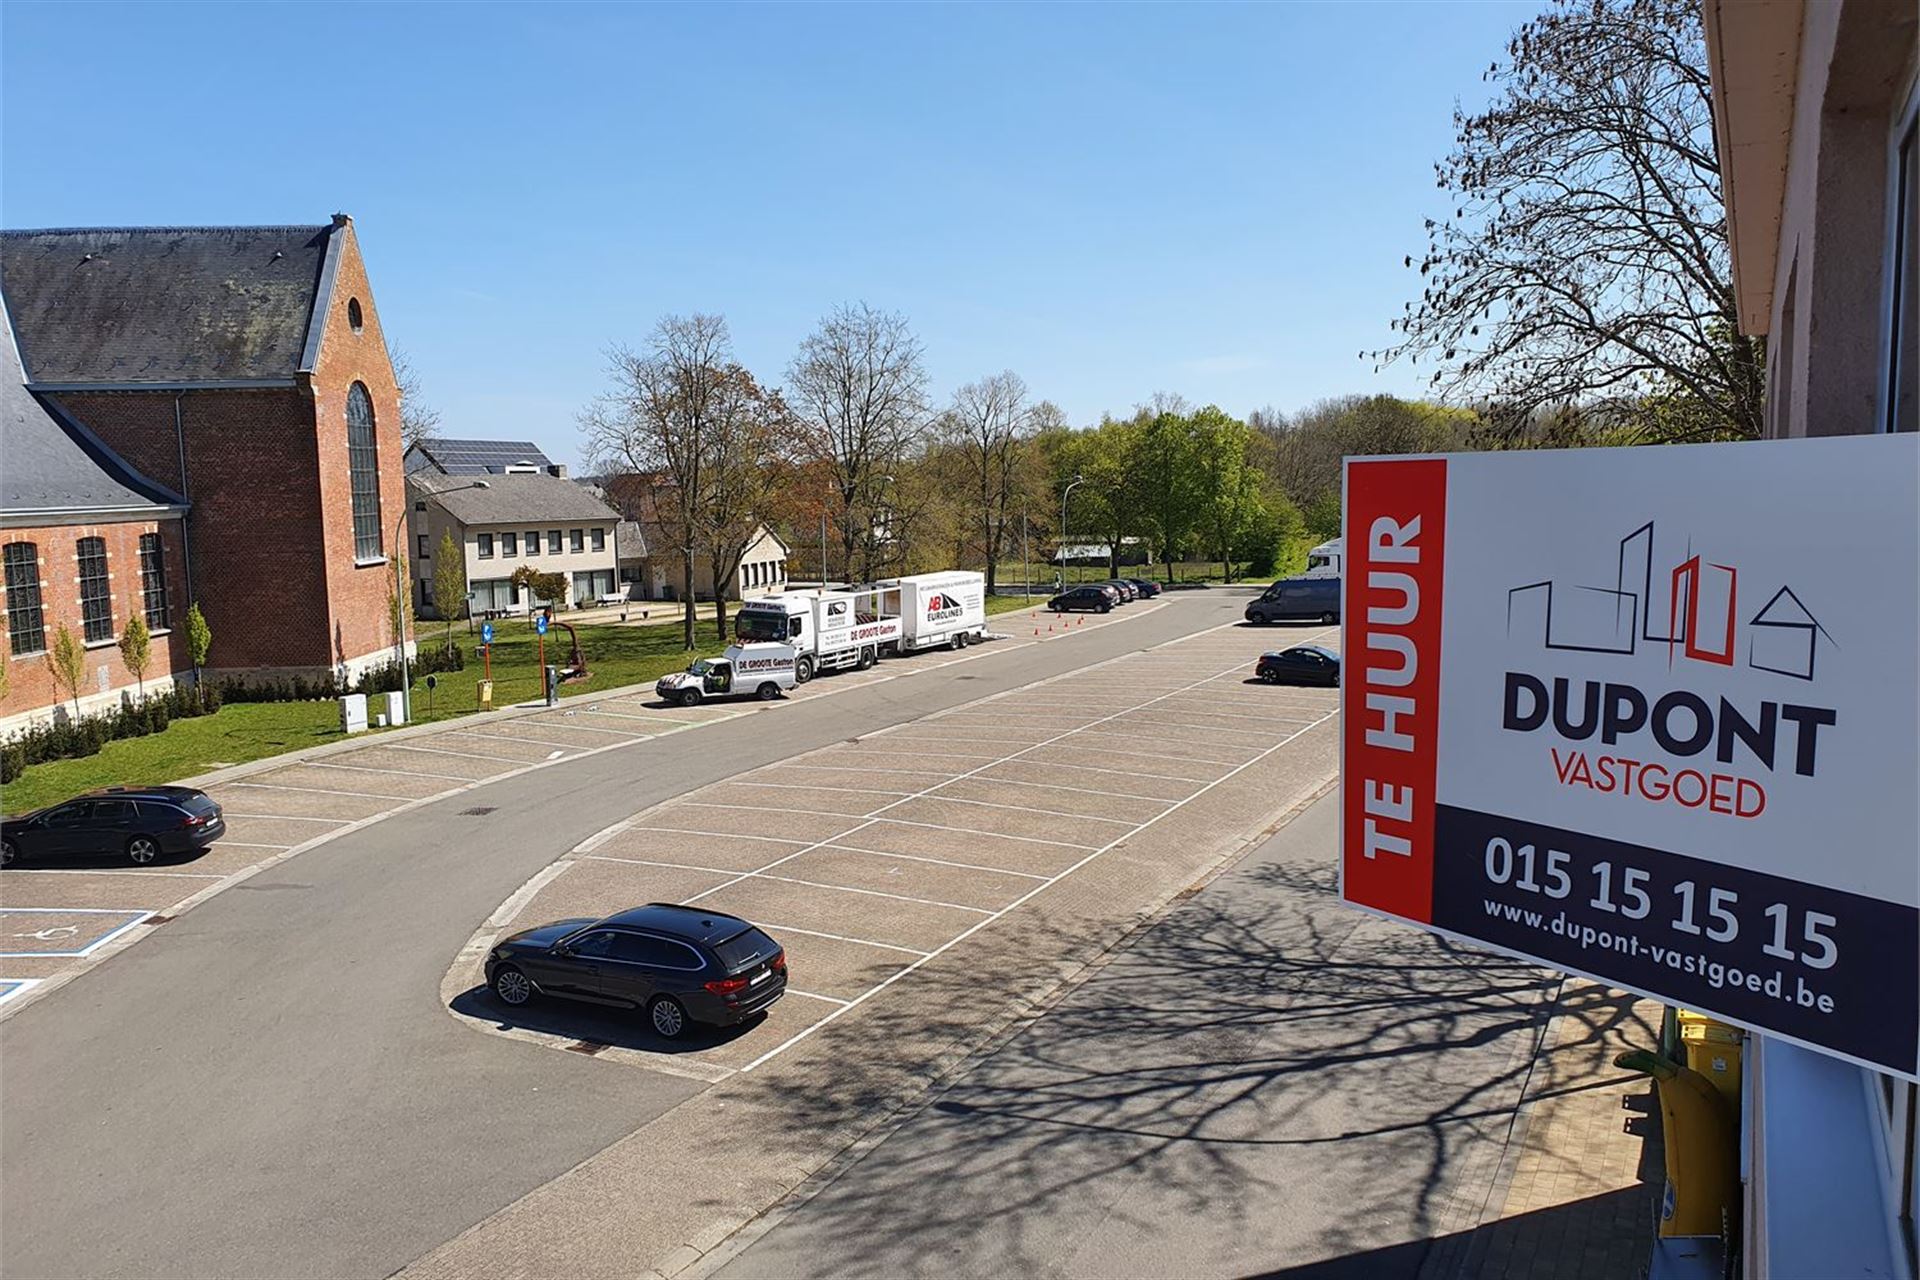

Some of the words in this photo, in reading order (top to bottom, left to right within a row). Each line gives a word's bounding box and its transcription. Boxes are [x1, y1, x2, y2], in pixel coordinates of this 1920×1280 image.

[850, 630, 858, 641] DE
[859, 625, 878, 639] GROOTE
[879, 624, 896, 635] Gaston
[927, 596, 941, 611] AB
[927, 608, 963, 621] EUROLINES
[1366, 514, 1421, 752] HUUR
[739, 661, 747, 669] DE
[748, 659, 772, 668] GROOTE
[773, 658, 793, 666] Gaston
[1503, 672, 1837, 777] DUPONT
[1364, 779, 1413, 859] TE
[1551, 748, 1767, 819] VASTGOED
[1485, 837, 1571, 899] 015
[1591, 861, 1651, 920] 15
[1673, 881, 1739, 943] 15
[1763, 903, 1838, 970] 15
[1484, 899, 1835, 1014] www.dupont-vastgoed.be
